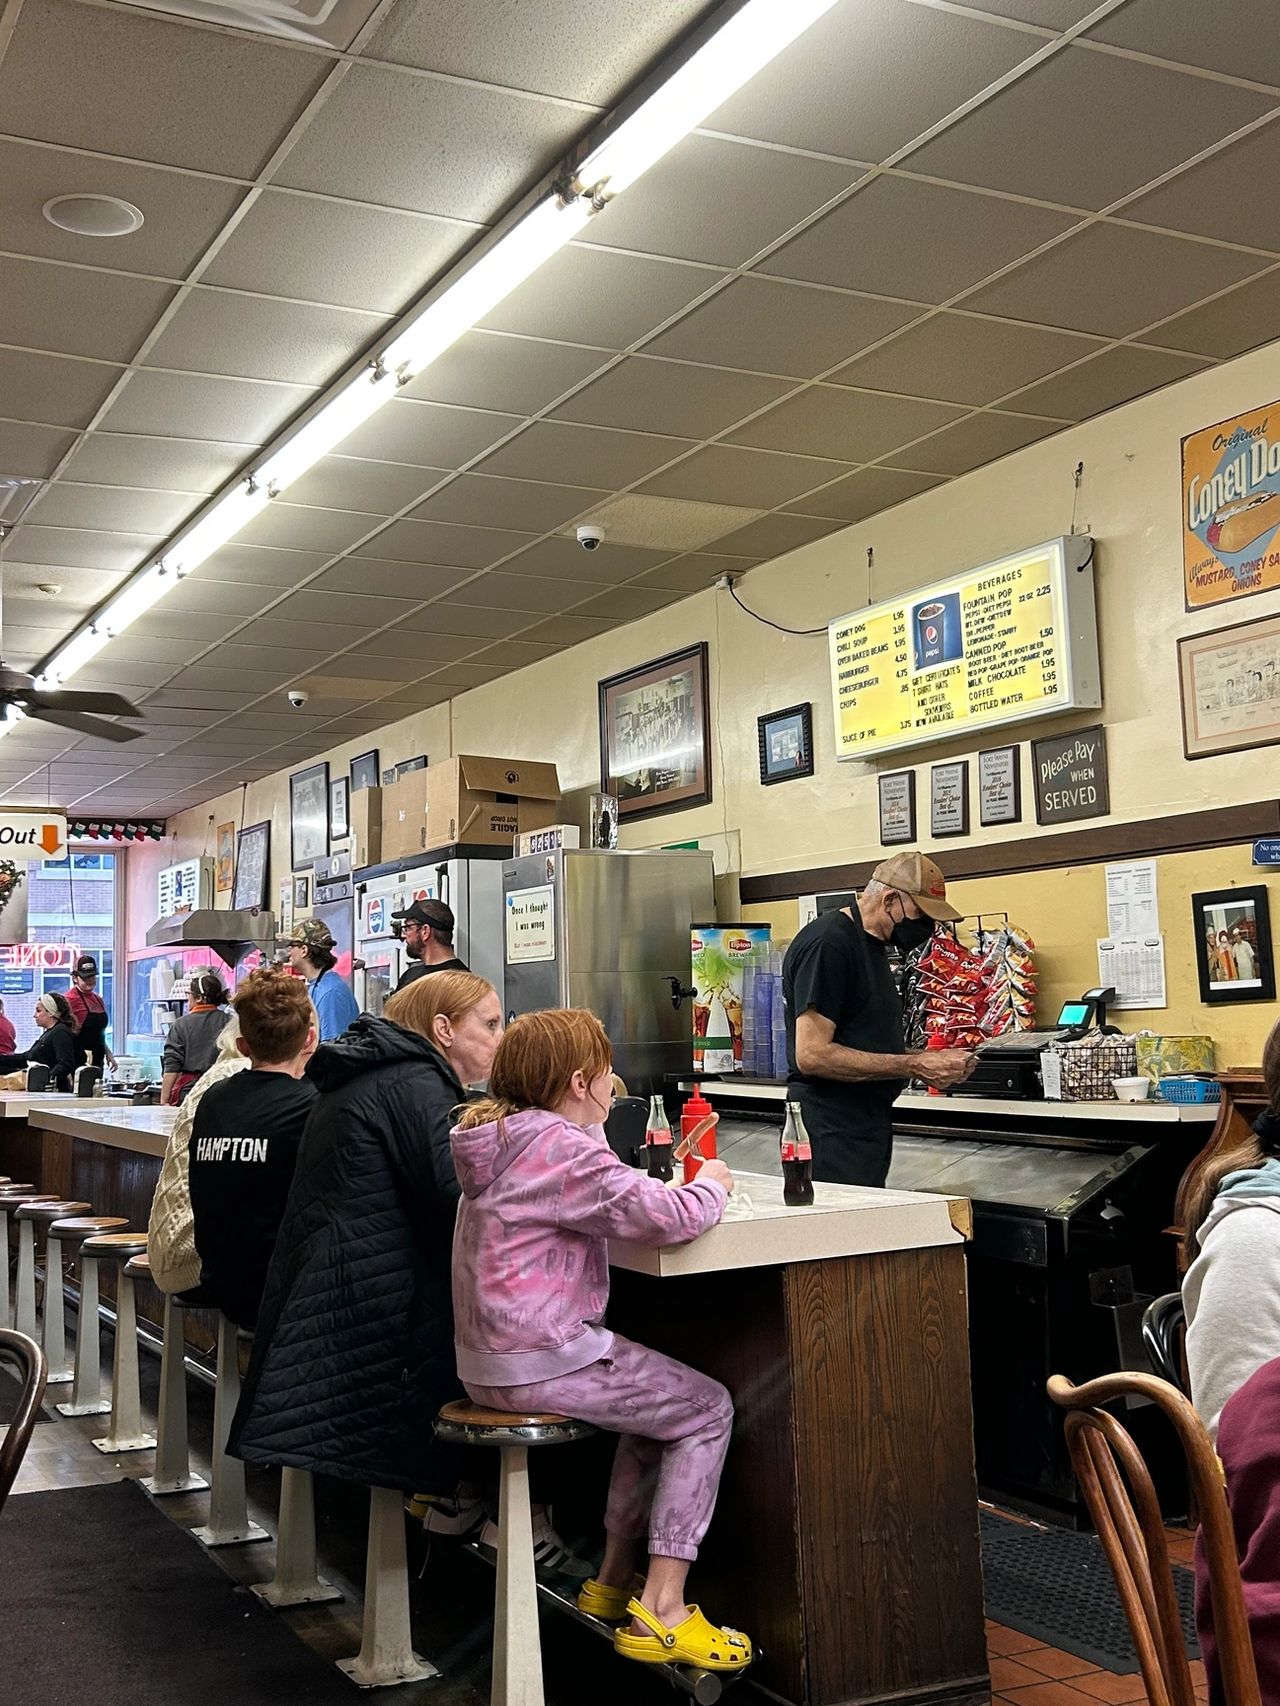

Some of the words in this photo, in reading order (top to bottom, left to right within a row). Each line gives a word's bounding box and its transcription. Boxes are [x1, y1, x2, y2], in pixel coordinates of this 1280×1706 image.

[1212, 418, 1268, 451] Original
[1188, 451, 1247, 531] Coney
[1189, 556, 1219, 582] Always
[1240, 556, 1266, 575] CONEY
[978, 569, 1022, 591] BEVERAGES
[1232, 573, 1261, 592] ONIONS
[963, 593, 995, 611] FOUNTAIN
[998, 588, 1012, 600] POP
[965, 609, 980, 620] PEPSI
[996, 599, 1011, 610] PEPSI
[1036, 584, 1051, 597] 2.25
[836, 627, 853, 640] CONEY
[854, 623, 866, 634] DOG
[853, 636, 868, 647] SOUP
[967, 633, 994, 646] LEMONADE
[1040, 627, 1053, 638] 1.50
[965, 645, 991, 659] CANNED
[993, 641, 1006, 651] POP
[968, 658, 982, 668] ROOT
[983, 655, 996, 664] BEER
[1001, 650, 1012, 658] DIET
[1014, 645, 1028, 655] ROOT
[1029, 641, 1044, 651] BEER
[978, 666, 987, 674] POP
[1043, 648, 1053, 656] POP
[968, 677, 982, 688] MILK
[987, 665, 1026, 683] CHOCOLATE
[1041, 658, 1055, 669] 1.95
[969, 687, 994, 700] COFFEE
[1043, 671, 1056, 682] 1.95
[840, 698, 857, 709] CHIPS
[970, 699, 998, 714] BOTTLED
[1001, 693, 1023, 705] WATER
[1043, 684, 1057, 696] 1.95
[868, 728, 877, 737] PIE
[1041, 749, 1074, 784] Please
[1075, 740, 1095, 762] Pay
[1070, 767, 1094, 783] WHEN
[1045, 786, 1096, 811] SERVED
[0, 826, 37, 845] Out
[512, 906, 523, 915] Once
[530, 901, 548, 914] thought
[531, 921, 545, 930] wrong
[196, 1137, 268, 1163] HAMPTON
